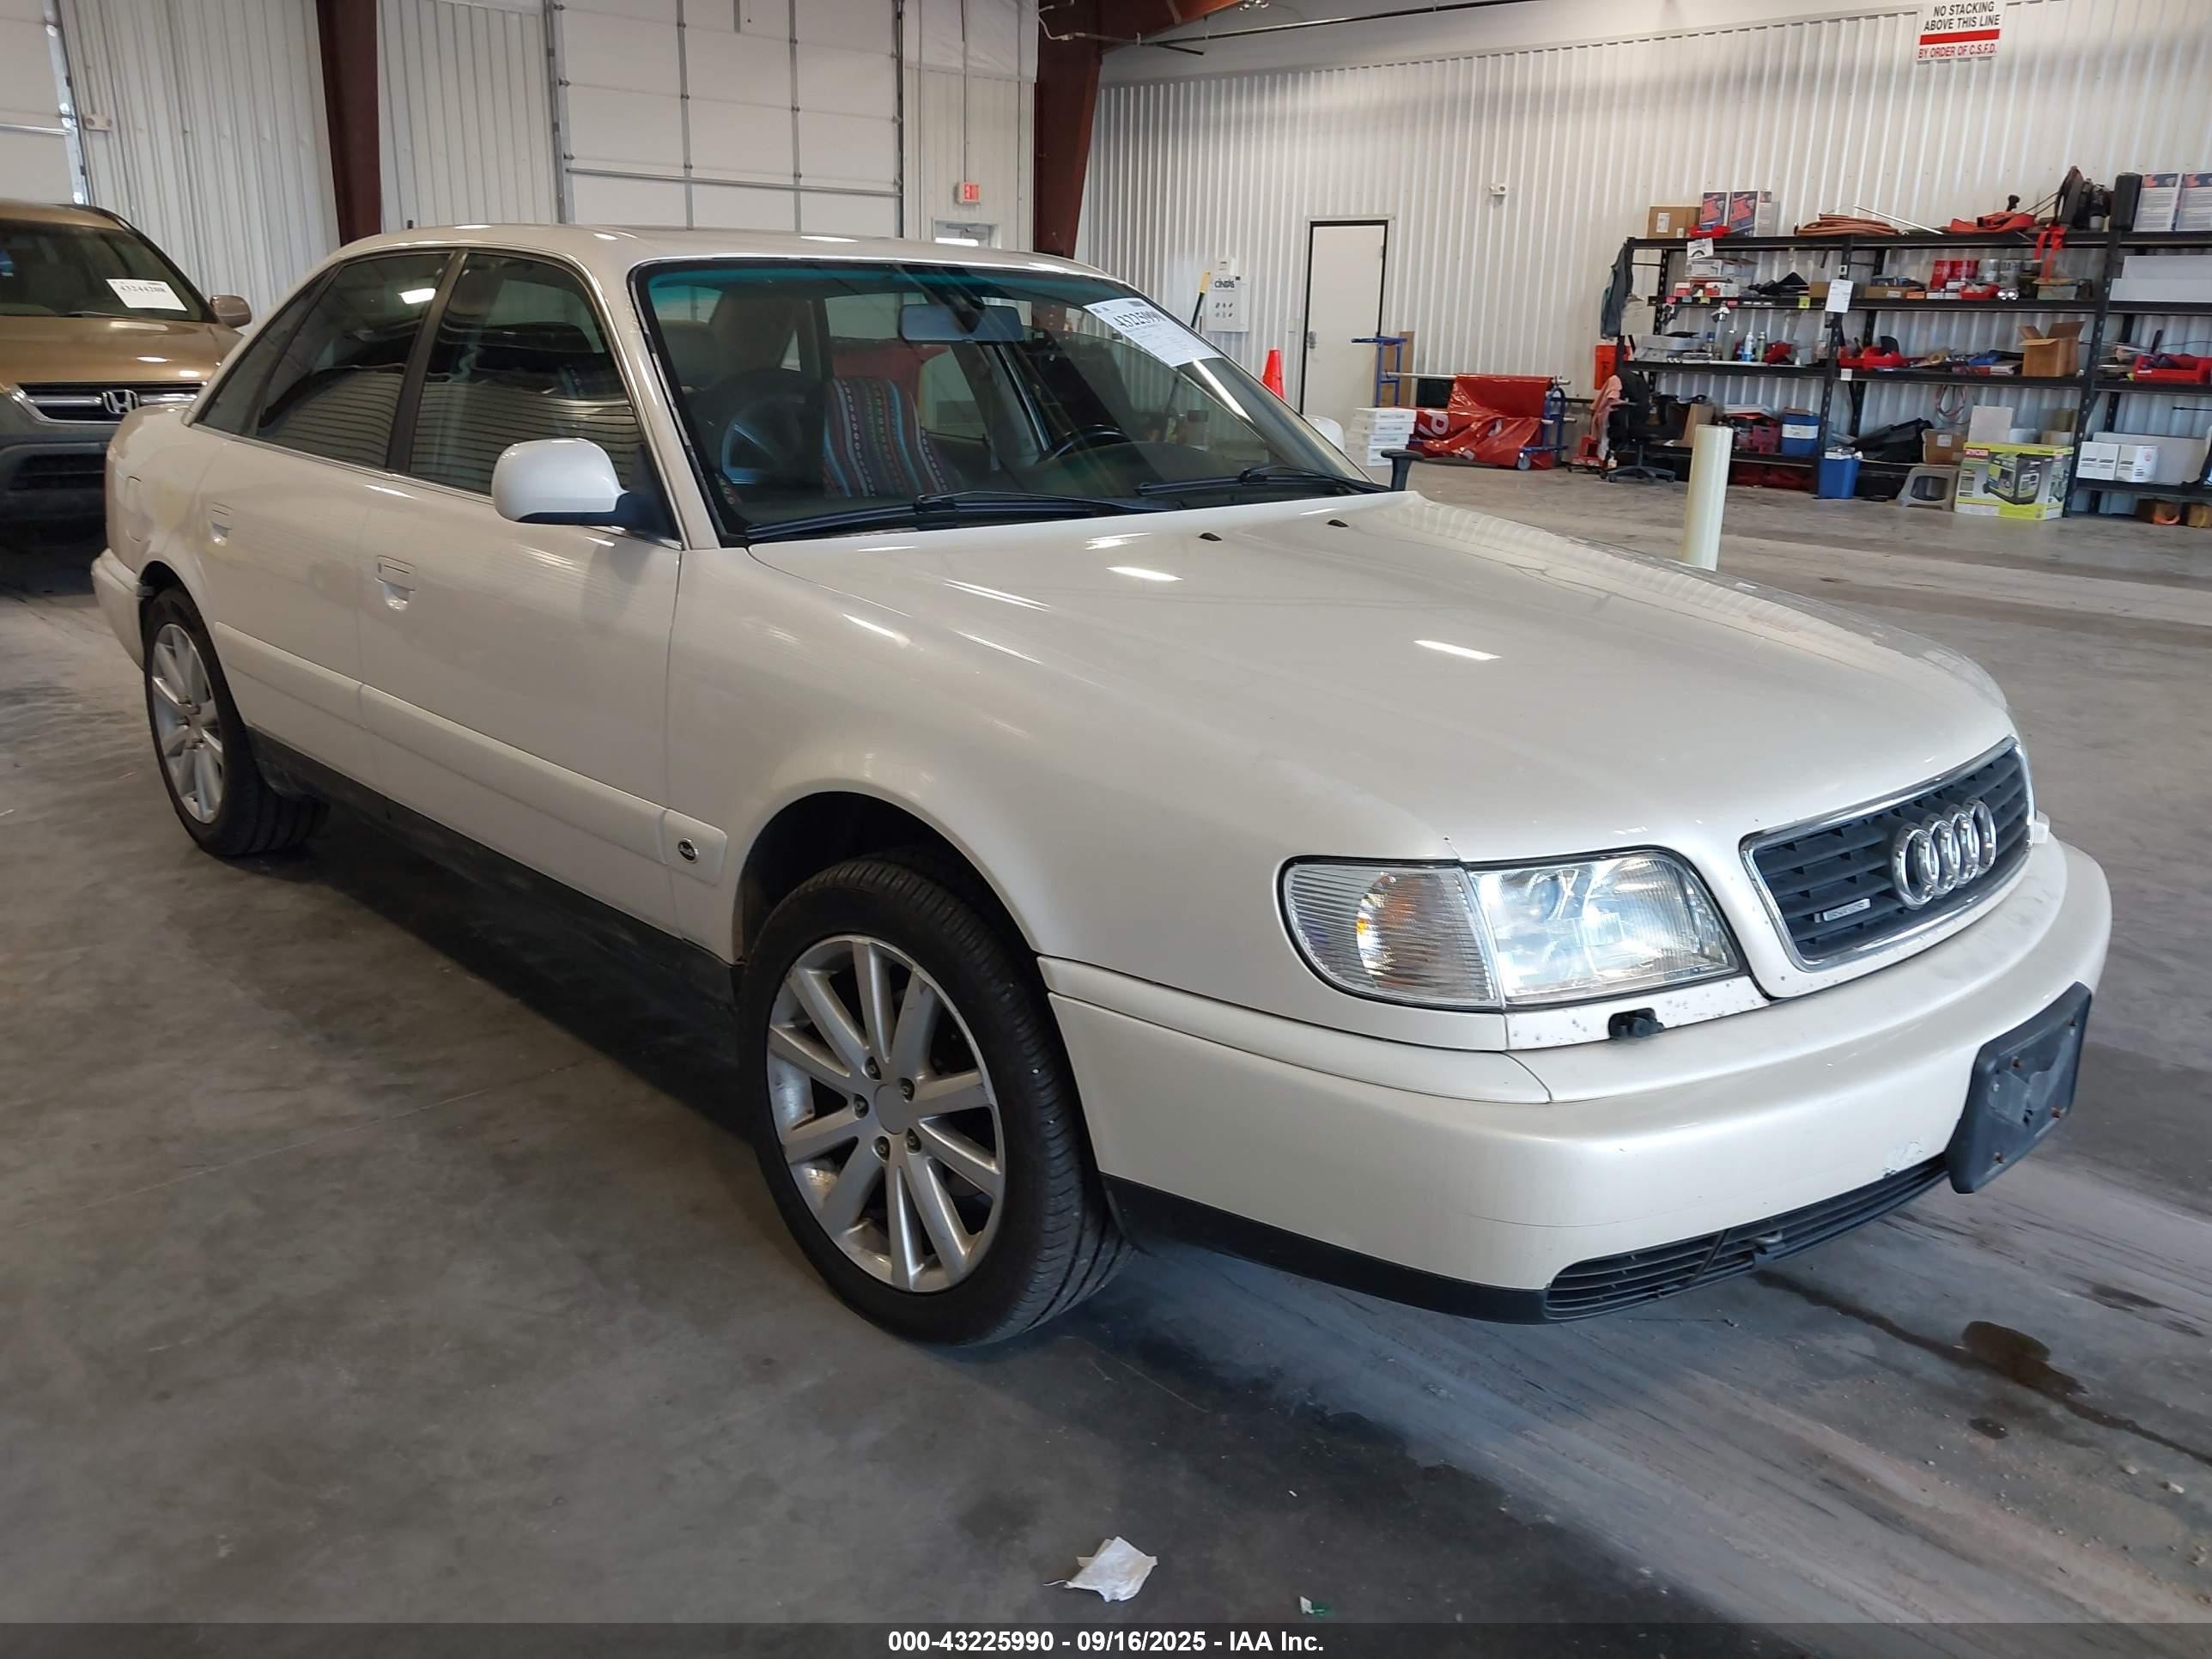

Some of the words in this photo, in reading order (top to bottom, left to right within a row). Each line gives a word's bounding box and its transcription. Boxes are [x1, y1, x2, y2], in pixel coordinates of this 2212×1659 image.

[1934, 6, 1946, 17] NO
[1948, 2, 1994, 15] STACKING
[1923, 19, 1954, 31] ABOVE
[1958, 16, 1977, 28] THIS
[1979, 15, 2001, 27] LINE
[1918, 48, 1929, 58] BY
[1930, 46, 1955, 58] ORDER
[1957, 46, 1967, 56] OF
